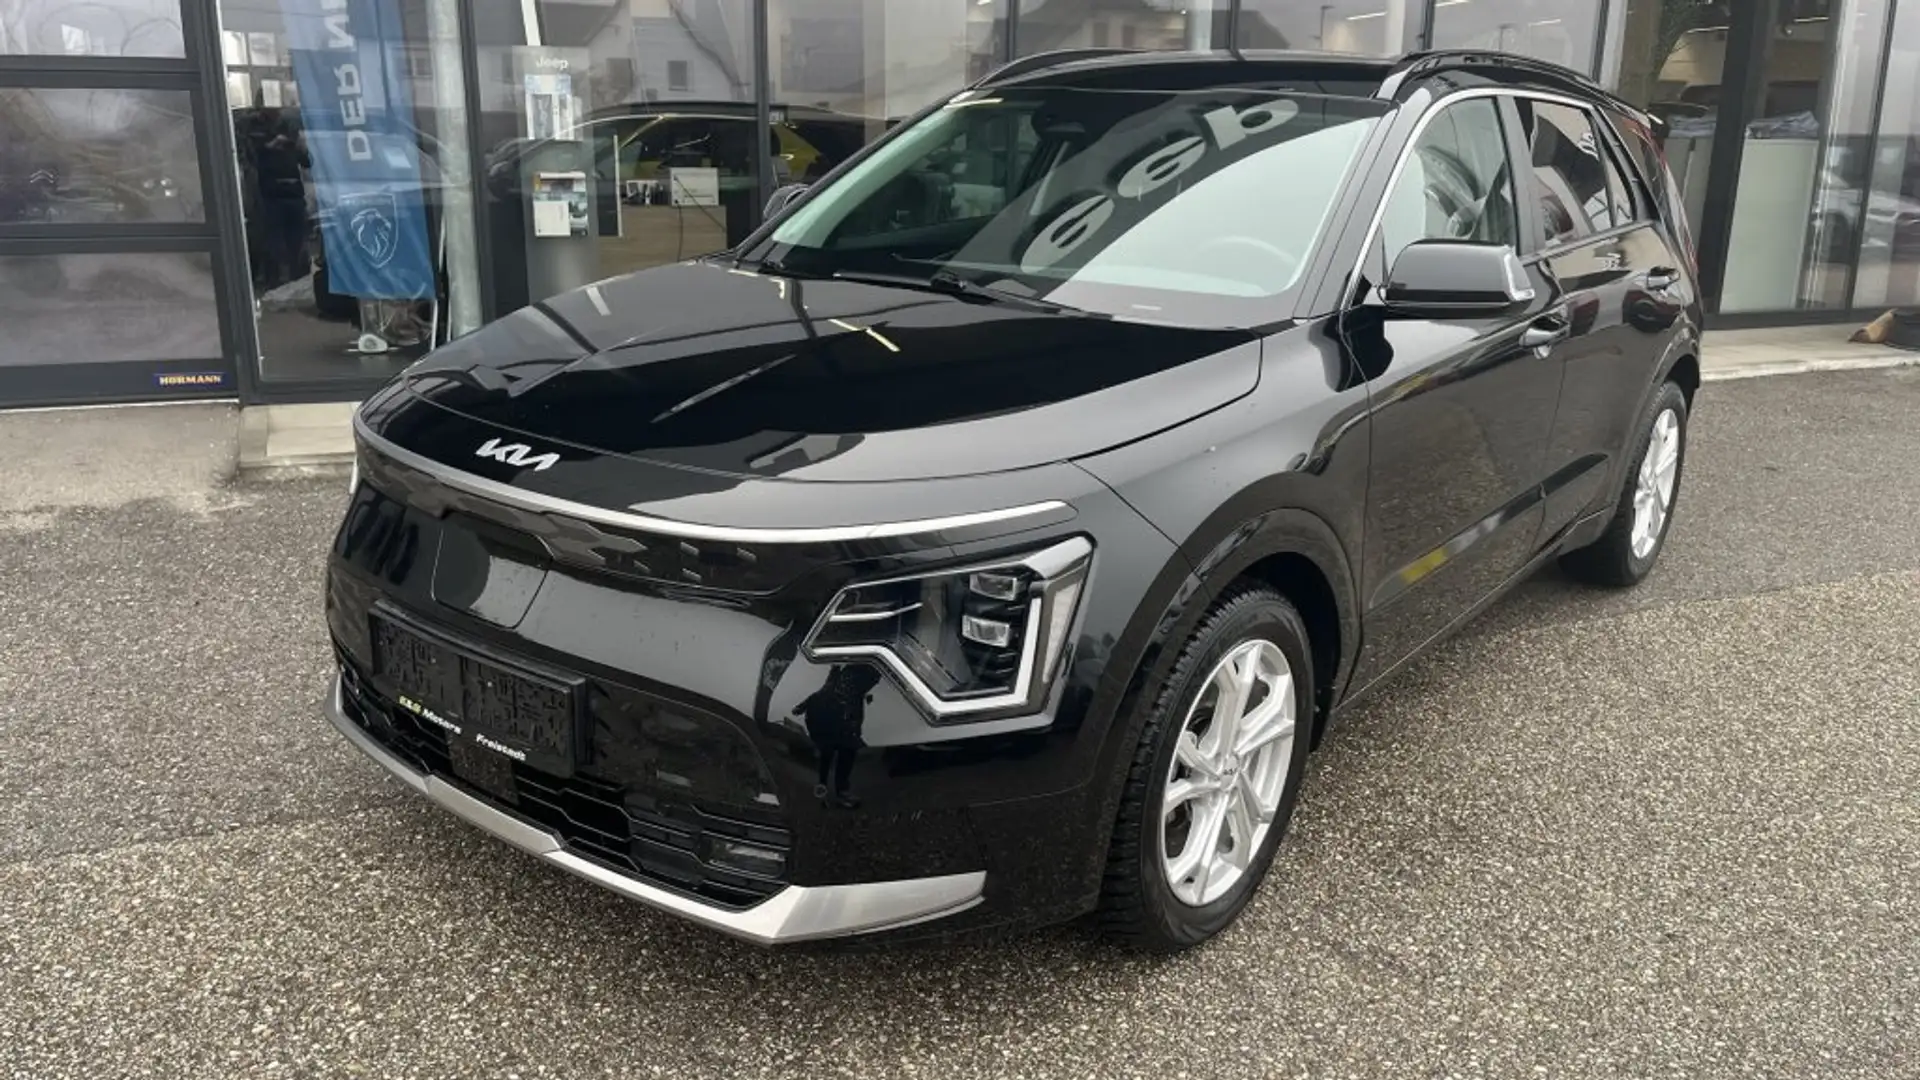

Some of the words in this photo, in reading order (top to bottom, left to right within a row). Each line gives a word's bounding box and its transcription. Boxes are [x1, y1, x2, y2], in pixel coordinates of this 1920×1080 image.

[535, 56, 569, 71] Jeep
[474, 437, 561, 472] KIA
[422, 707, 462, 734] Motors
[475, 732, 526, 761] Freistadt
